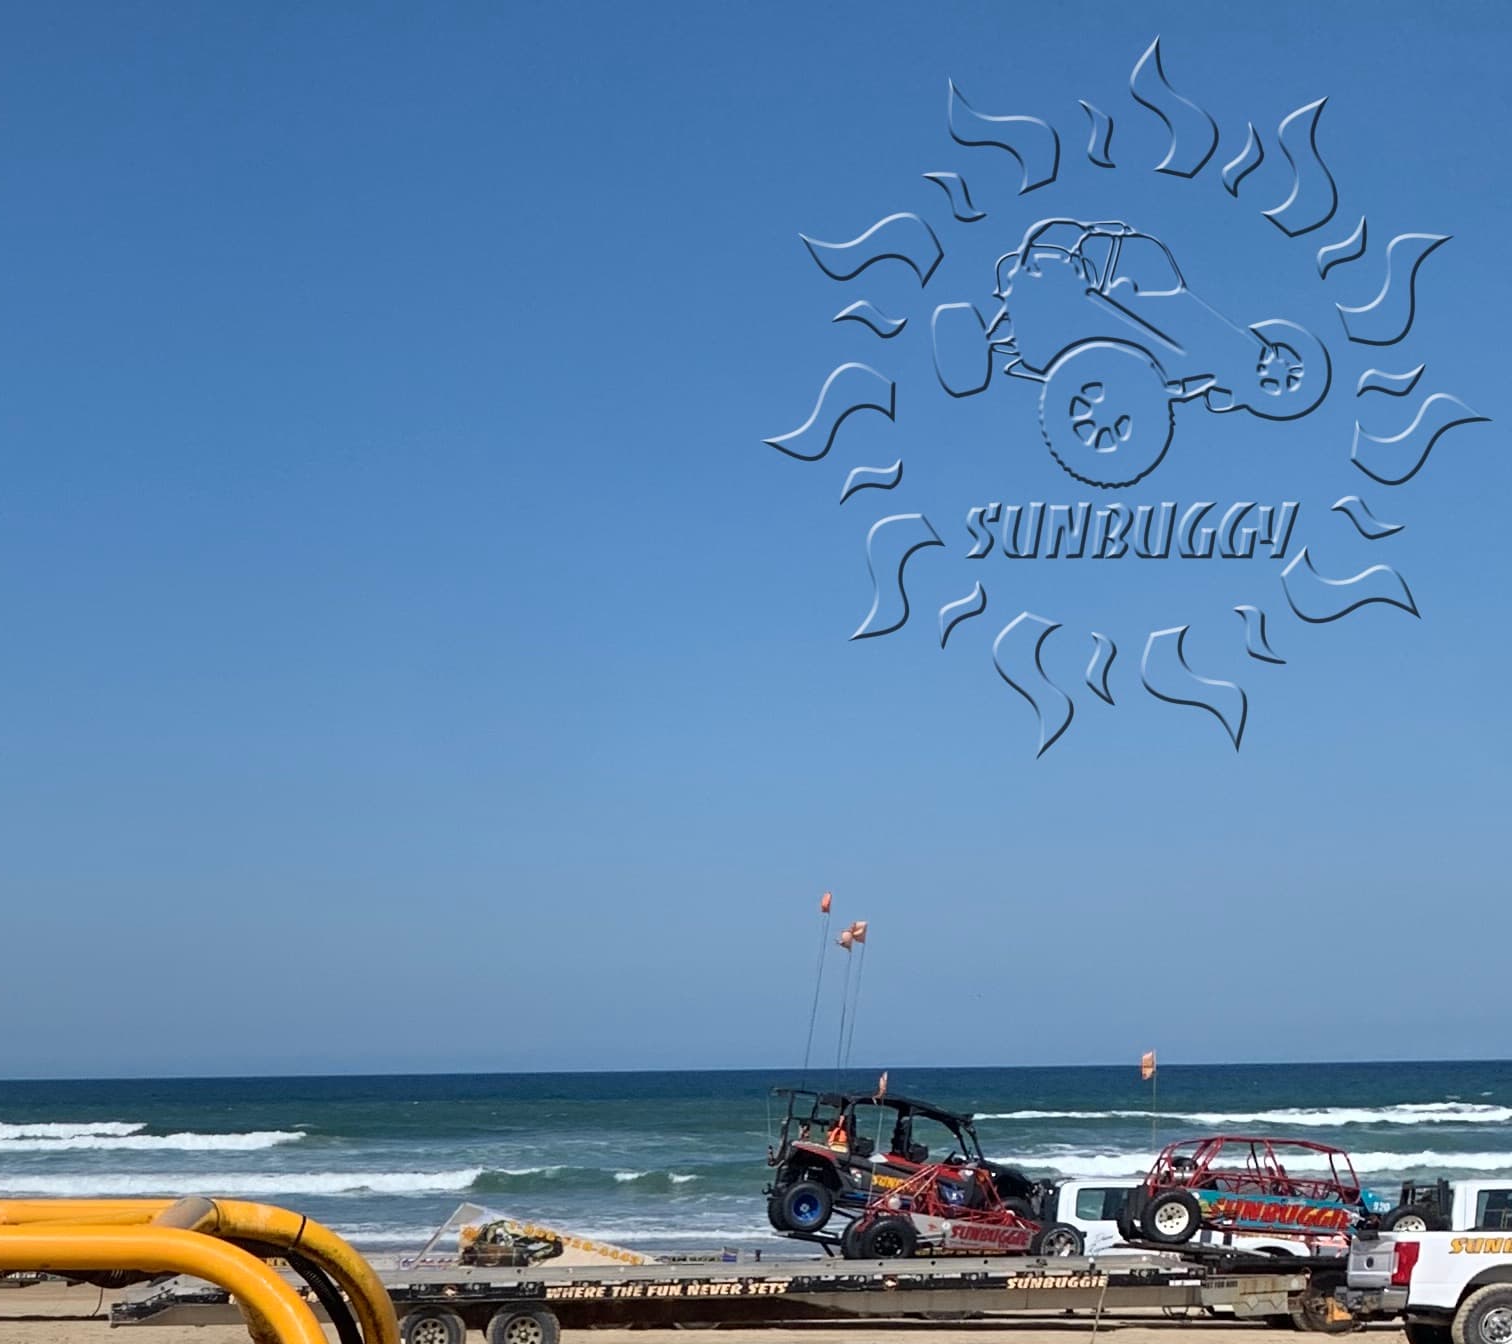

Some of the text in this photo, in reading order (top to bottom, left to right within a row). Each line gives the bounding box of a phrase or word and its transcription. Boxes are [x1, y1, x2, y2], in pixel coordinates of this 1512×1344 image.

[546, 1286, 606, 1299] WHERE
[612, 1285, 643, 1298] THE
[687, 1283, 743, 1297] NEVER
[747, 1281, 789, 1295] SETS
[1007, 1275, 1108, 1290] SUNBUGGIE
